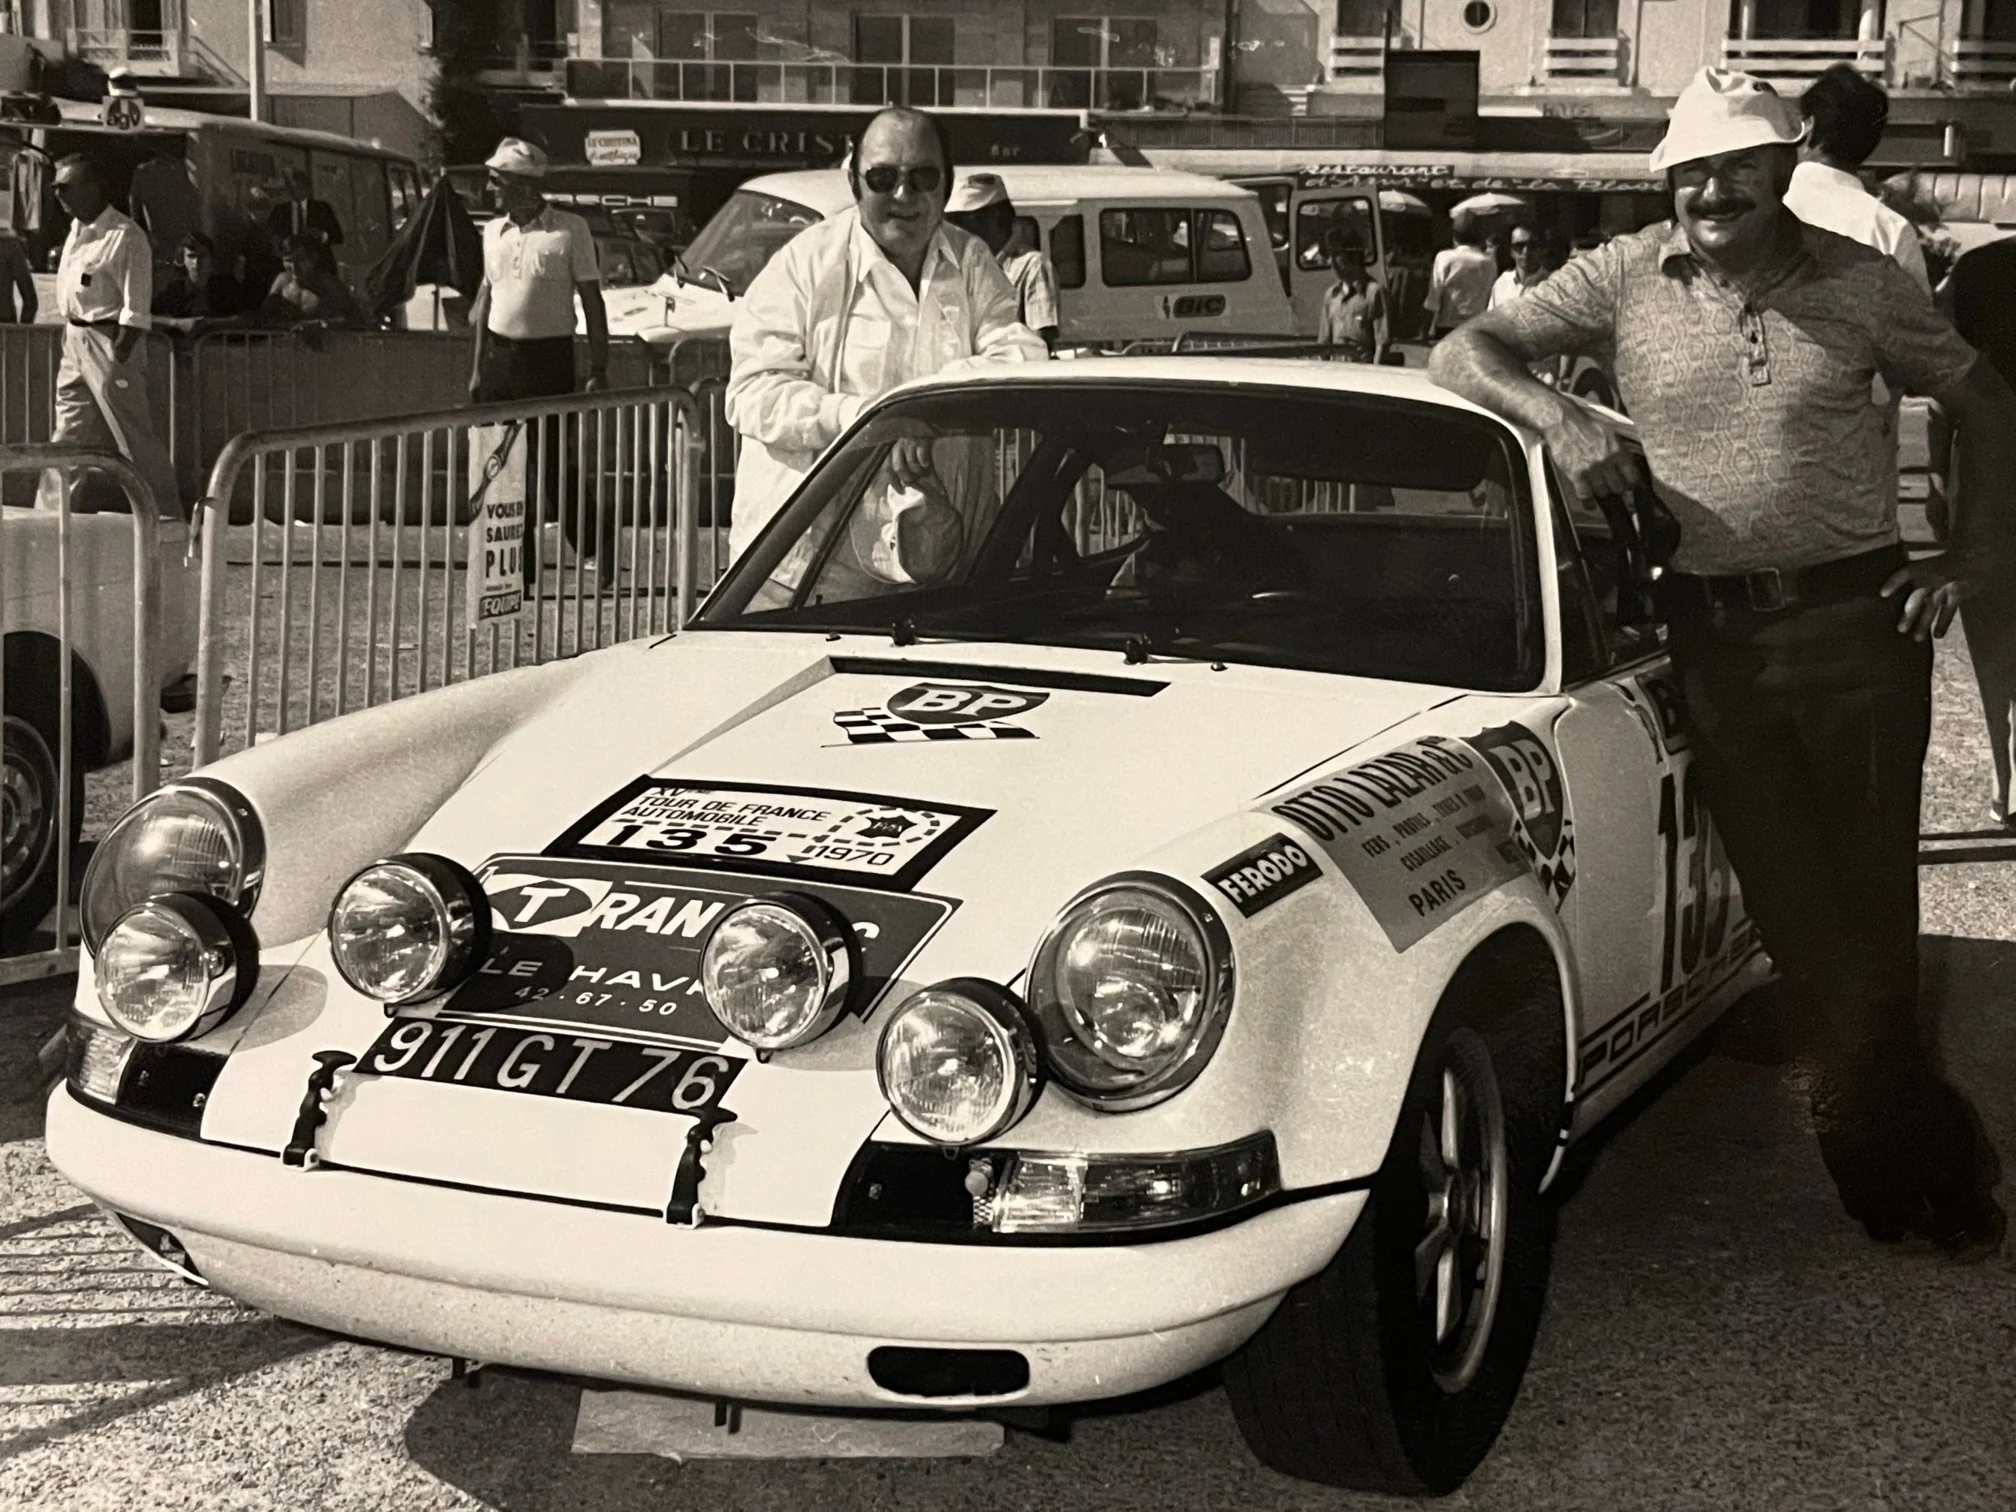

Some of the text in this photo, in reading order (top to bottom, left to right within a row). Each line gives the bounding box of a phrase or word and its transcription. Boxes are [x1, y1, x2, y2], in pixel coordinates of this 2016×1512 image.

[681, 130, 855, 155] LE CRIST
[1175, 298, 1223, 316] BIC
[897, 689, 1027, 717] BP
[1488, 739, 1556, 821] BP
[638, 796, 831, 822] TOUR DE FRANCE
[1271, 785, 1375, 842] OTTO
[1333, 751, 1447, 808] LAZAR
[621, 806, 769, 827] AUTOMOBILE
[606, 824, 777, 856] 135
[811, 845, 896, 867] 1970
[1217, 845, 1308, 903] FERODO
[1408, 869, 1467, 917] PARIS
[478, 957, 543, 977] LE
[373, 1021, 729, 1111] 911 GT 76
